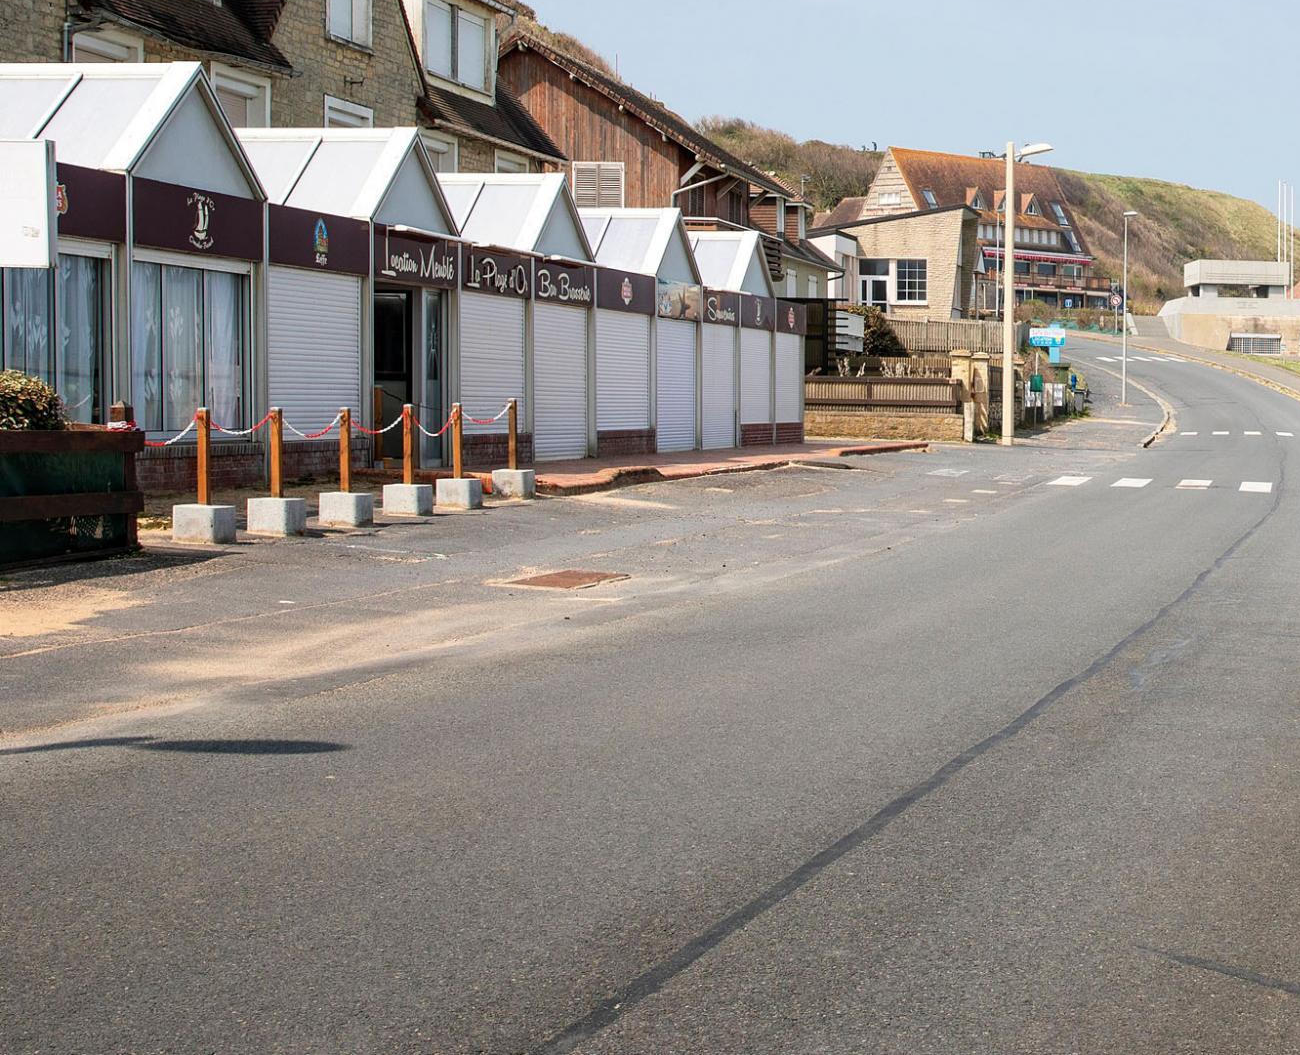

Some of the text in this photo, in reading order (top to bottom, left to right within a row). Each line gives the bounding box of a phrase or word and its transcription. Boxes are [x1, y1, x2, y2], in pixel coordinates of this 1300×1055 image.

[381, 237, 455, 280] Location Meublé
[466, 254, 481, 288] La
[482, 257, 507, 293] Plage
[558, 273, 592, 302] Brasserie
